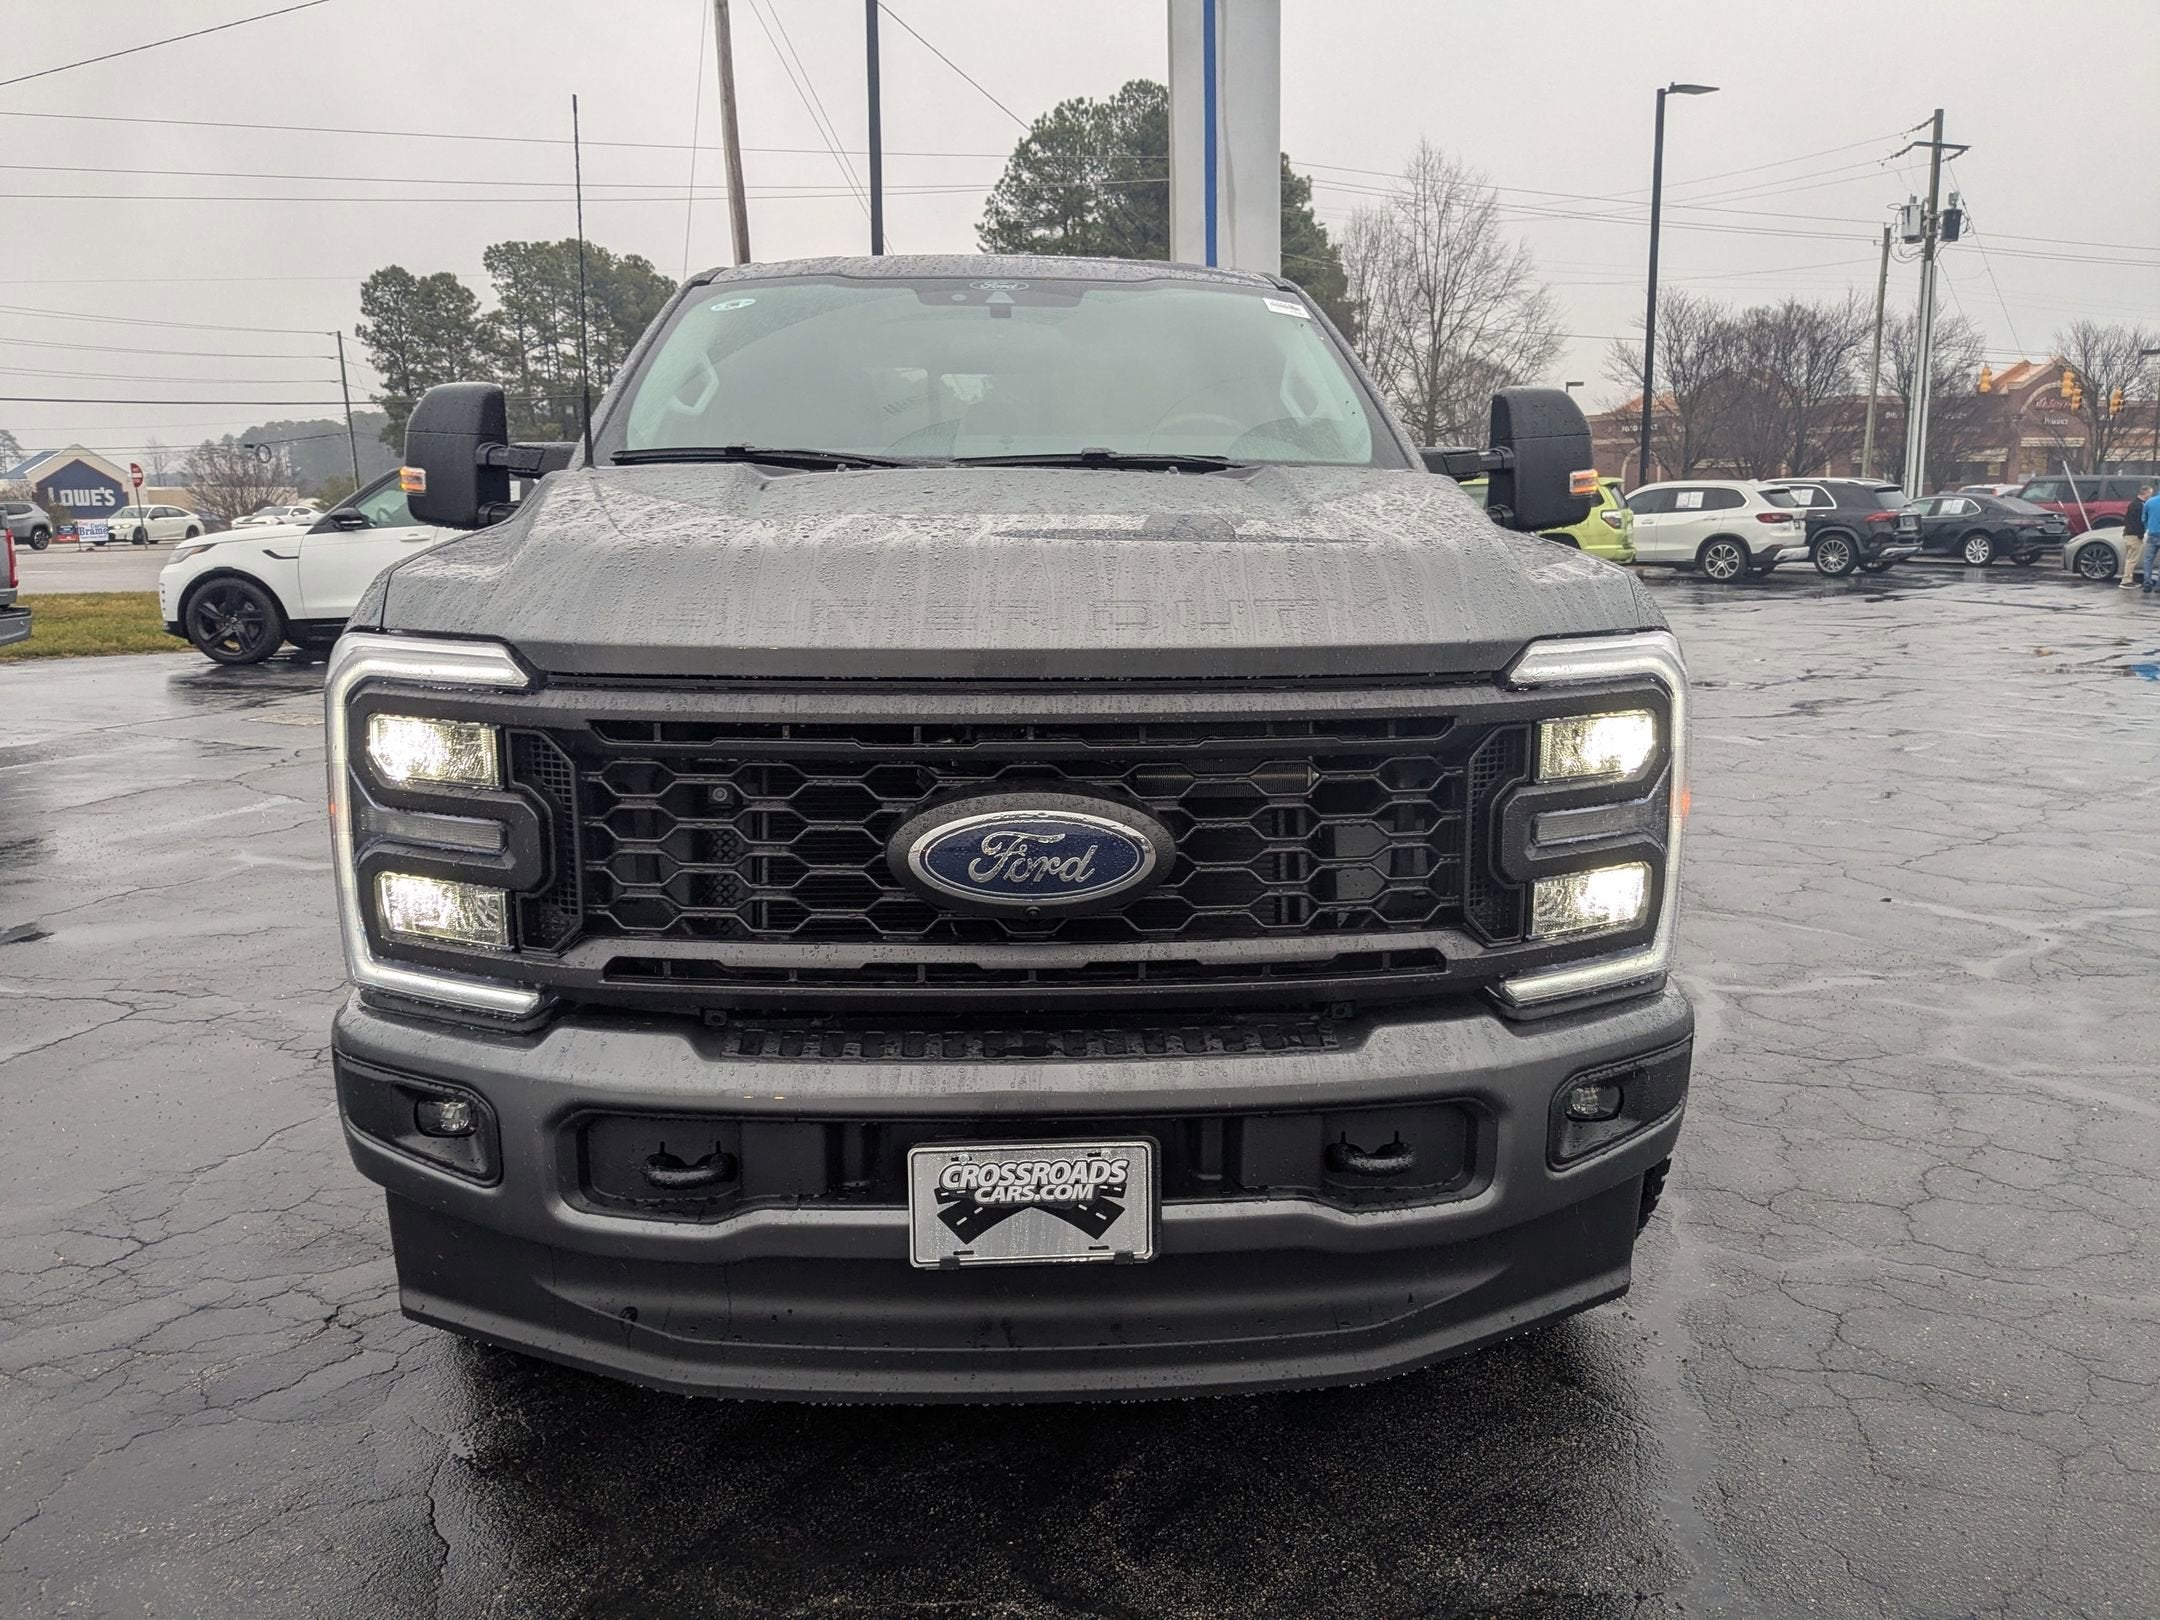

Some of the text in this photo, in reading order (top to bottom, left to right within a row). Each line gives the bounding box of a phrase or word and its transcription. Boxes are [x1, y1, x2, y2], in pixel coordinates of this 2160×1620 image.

[47, 486, 116, 507] LOWE'S
[79, 526, 109, 536] Brame
[967, 830, 1099, 884] Ford
[938, 1158, 1130, 1190] CROSSROADS
[973, 1182, 1096, 1204] CARS.COM
